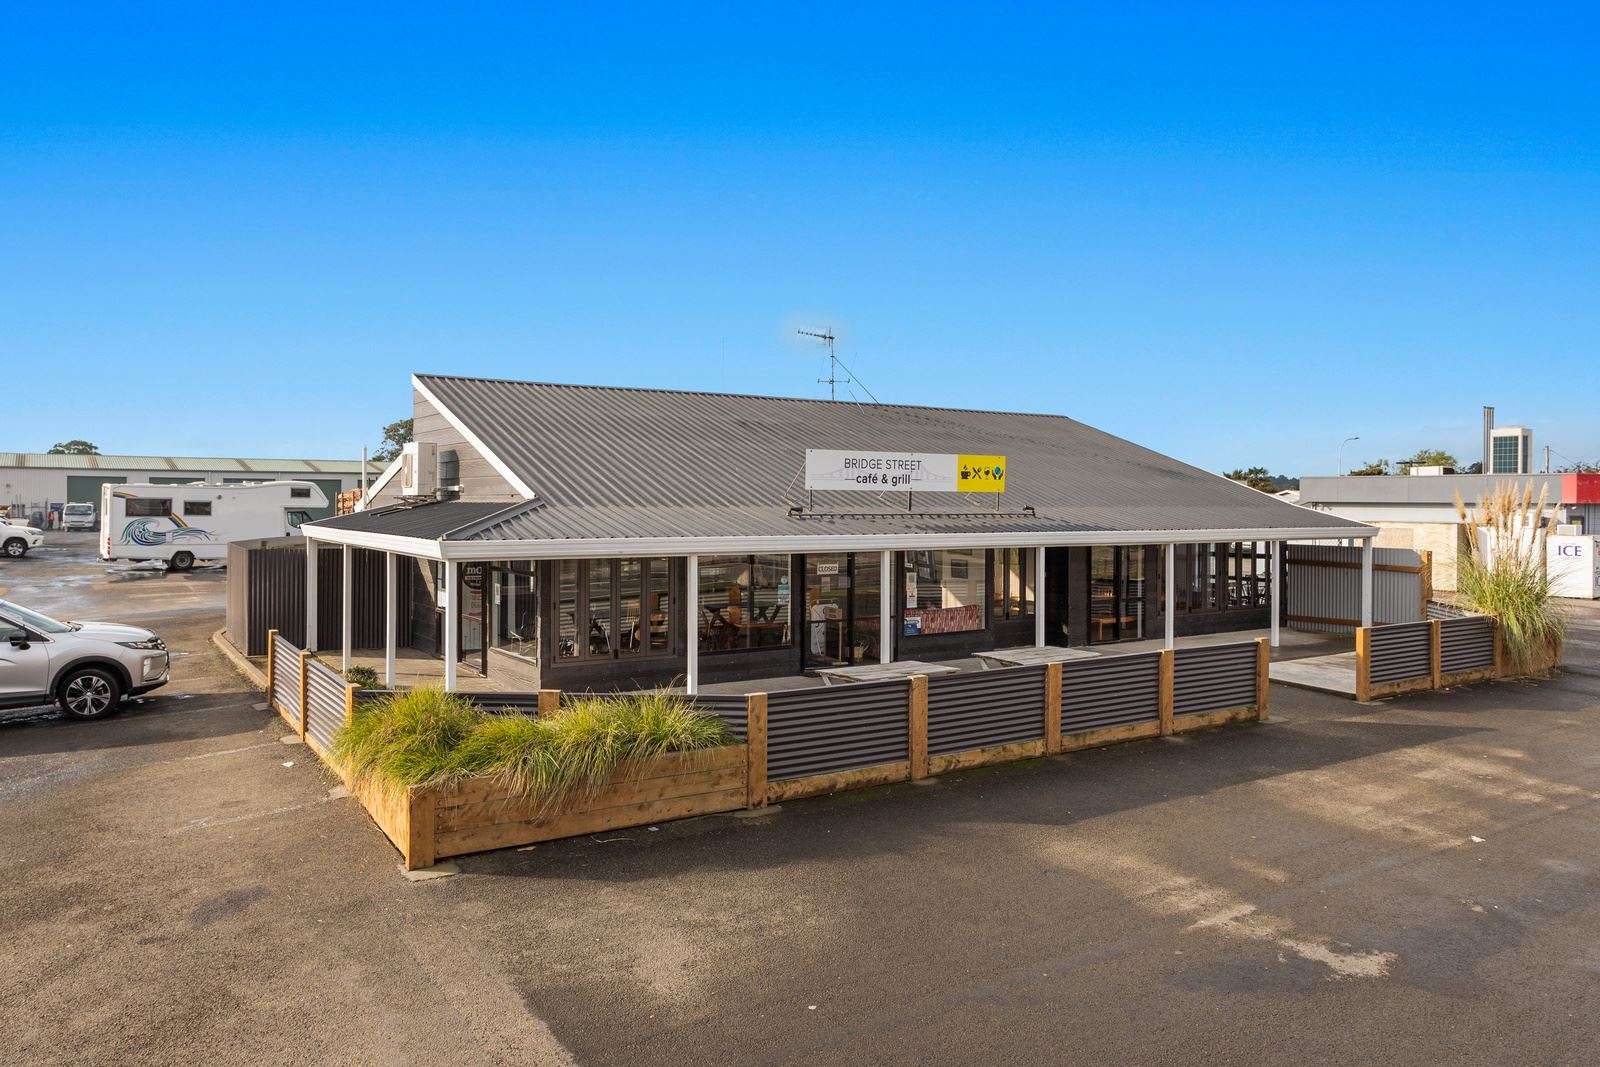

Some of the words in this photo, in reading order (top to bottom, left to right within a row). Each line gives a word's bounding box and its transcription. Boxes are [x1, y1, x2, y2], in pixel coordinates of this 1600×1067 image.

[844, 458, 882, 469] BRIDGE
[885, 459, 922, 470] STREET
[856, 473, 878, 484] café
[881, 473, 888, 484] &
[891, 474, 911, 487] grill
[1558, 545, 1582, 557] ICE
[818, 565, 838, 573] CLOSED
